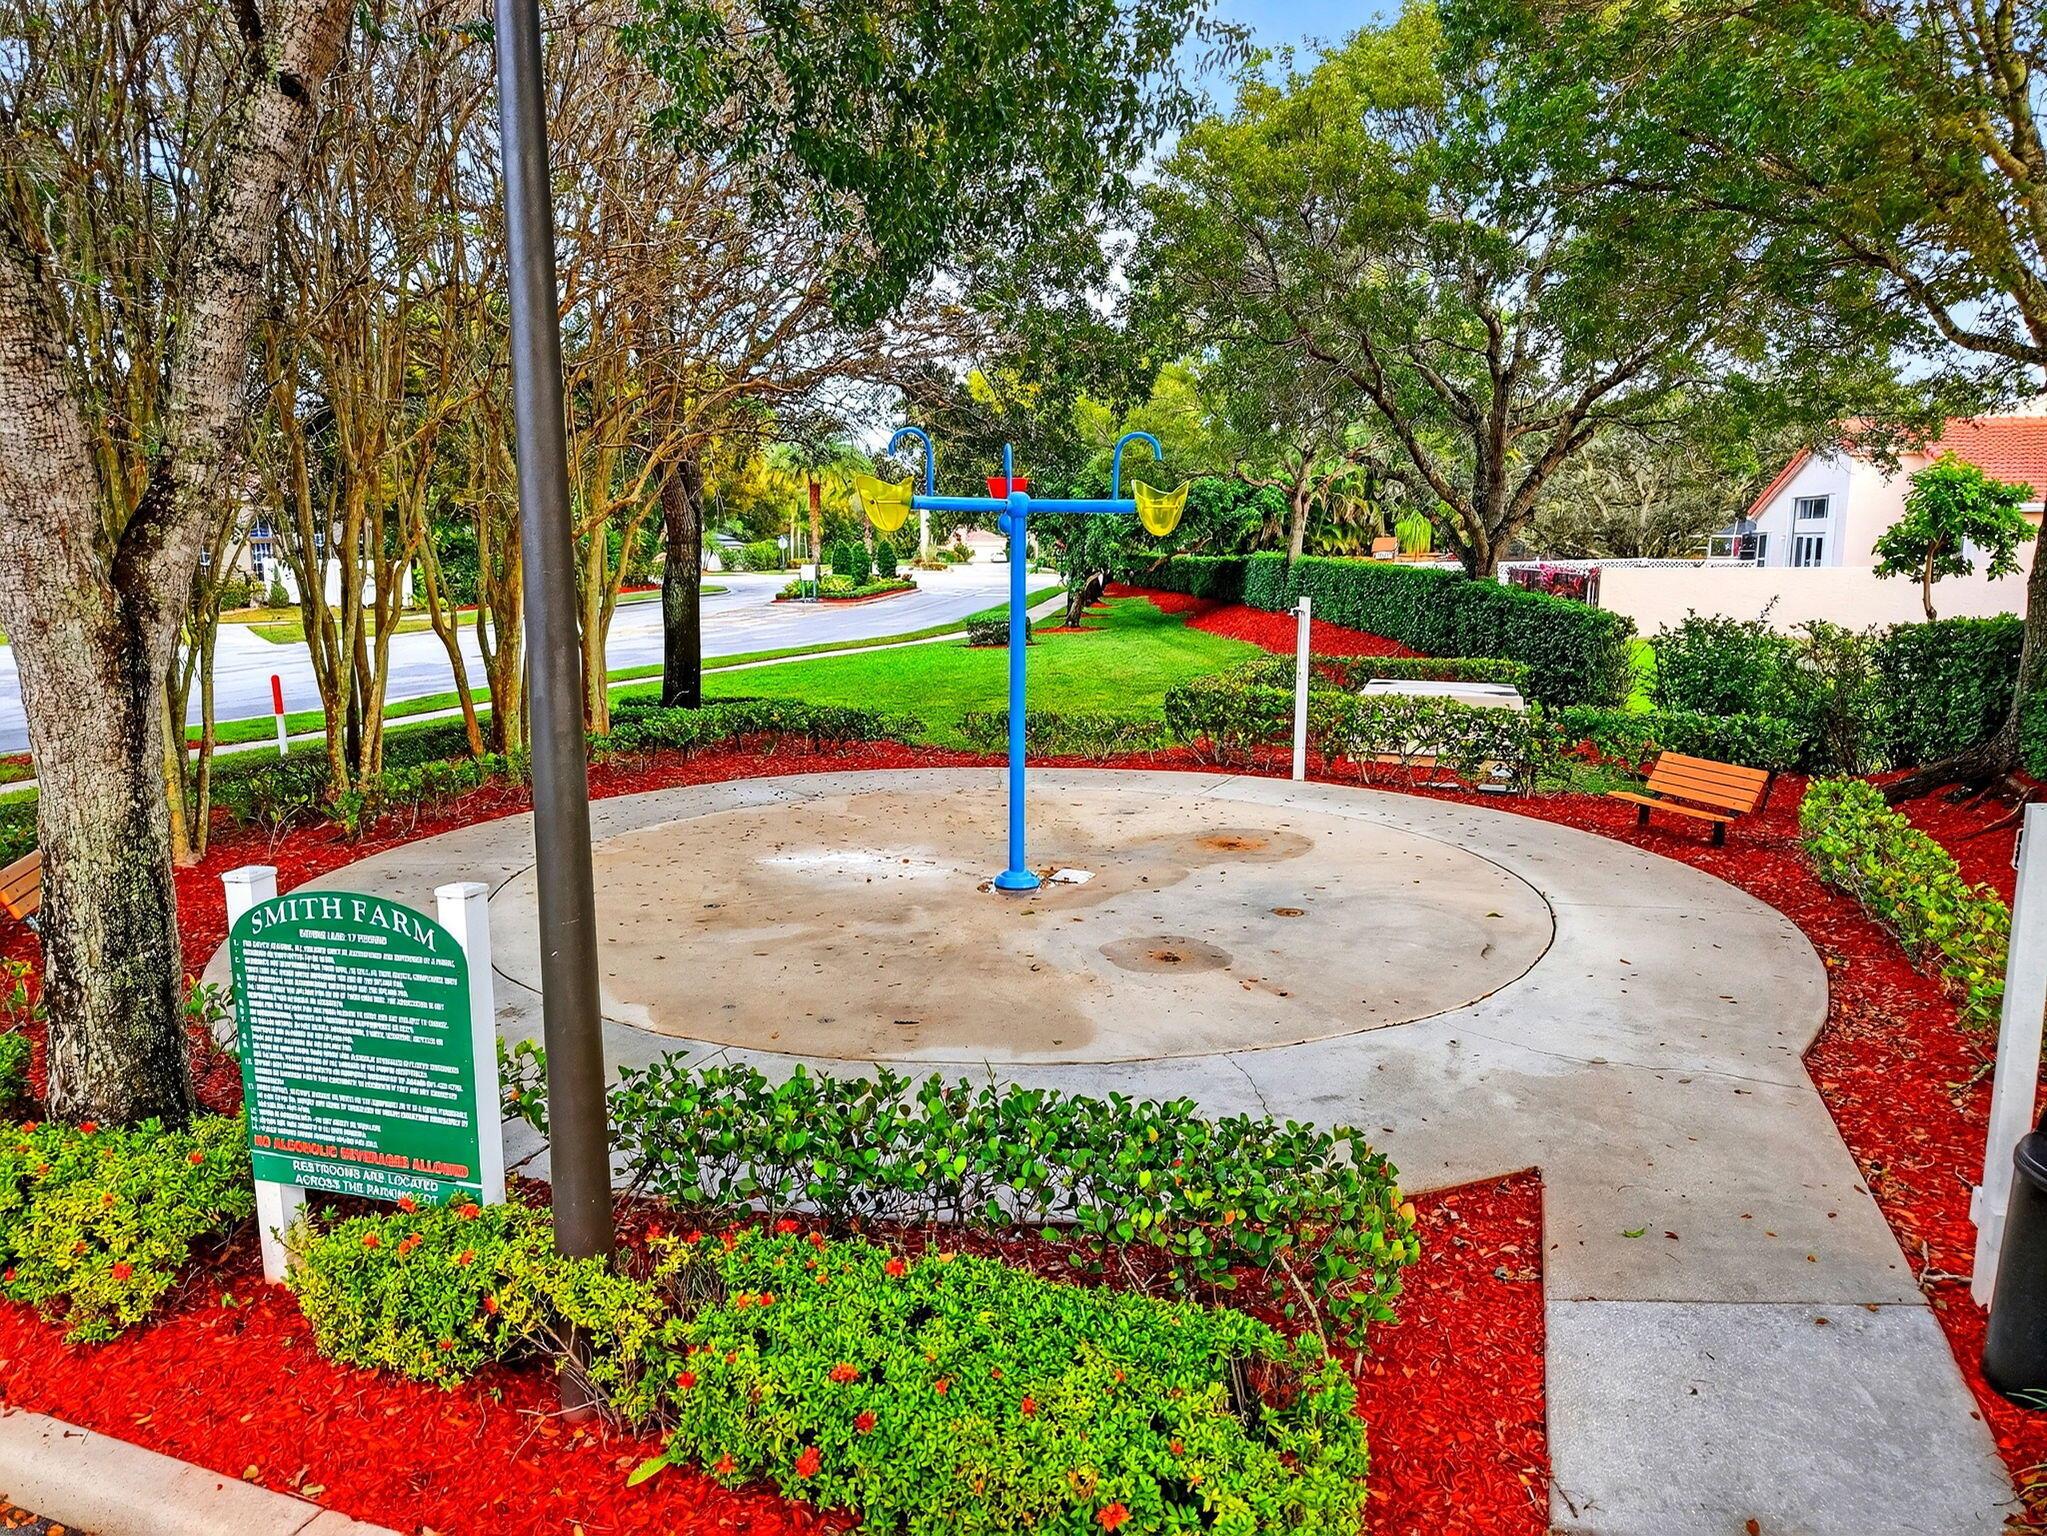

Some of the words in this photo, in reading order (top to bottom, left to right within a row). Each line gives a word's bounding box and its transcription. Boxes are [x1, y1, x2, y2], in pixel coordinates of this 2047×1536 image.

[251, 897, 344, 936] SMITH
[352, 899, 437, 953] FARM
[254, 1135, 271, 1148] NO
[273, 1137, 338, 1158] ALCOHOLIC
[293, 1160, 361, 1179] RESTROOMS
[363, 1169, 385, 1184] ARE
[388, 1174, 439, 1192] LOCATED
[295, 1174, 341, 1190] ACROSS
[342, 1180, 364, 1194] THE
